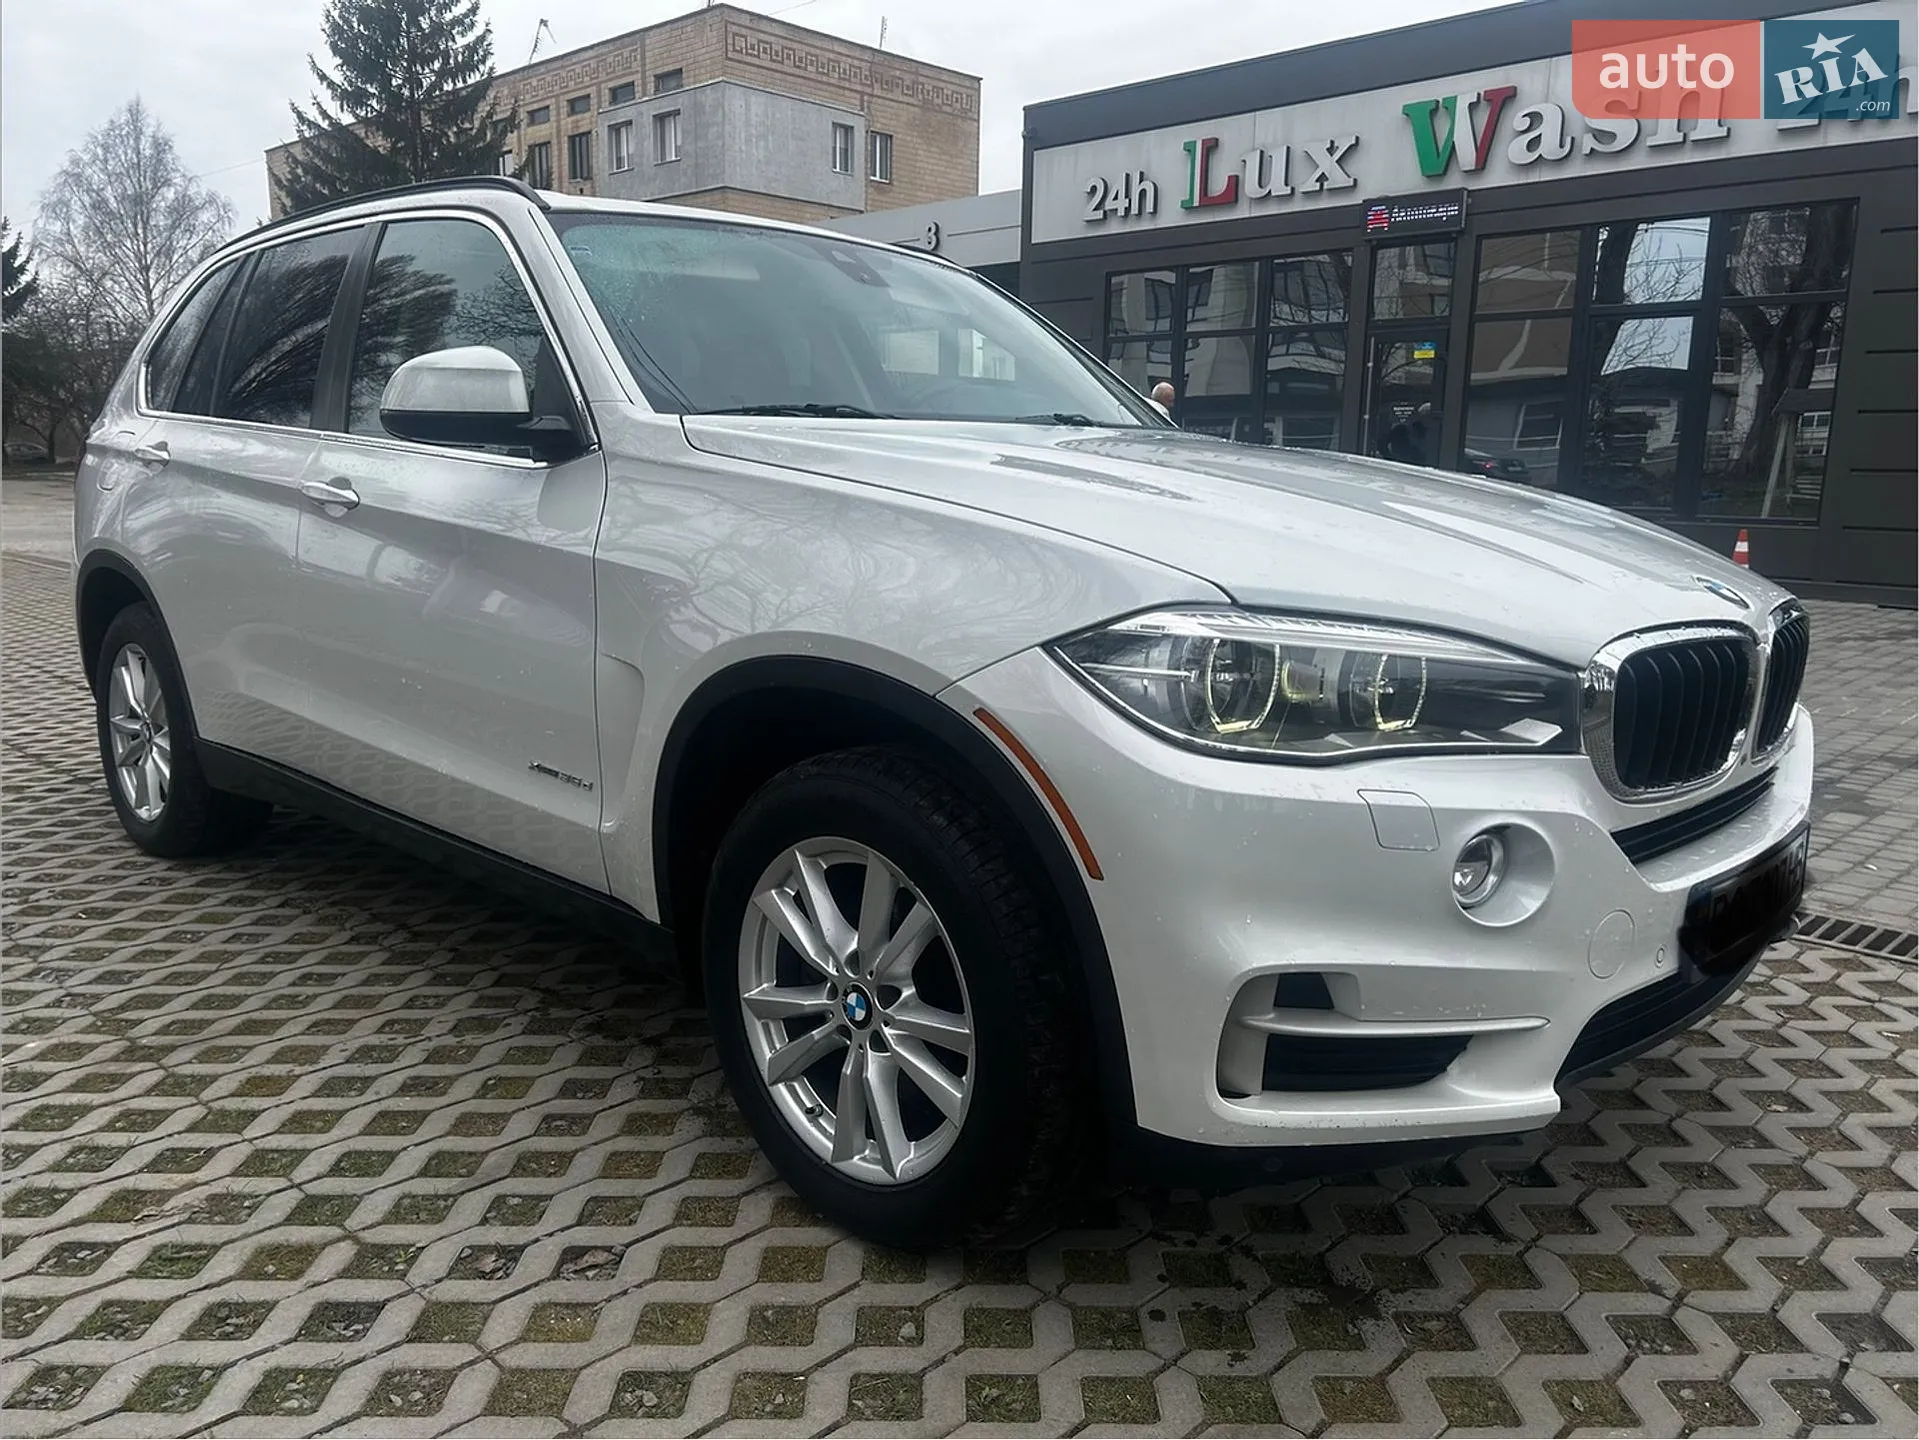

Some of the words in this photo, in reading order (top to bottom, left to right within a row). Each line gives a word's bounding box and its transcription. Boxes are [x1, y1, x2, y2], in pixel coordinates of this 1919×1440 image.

[1083, 170, 1158, 222] 24h
[1180, 135, 1360, 210] Lux
[1402, 62, 1731, 178] Wash
